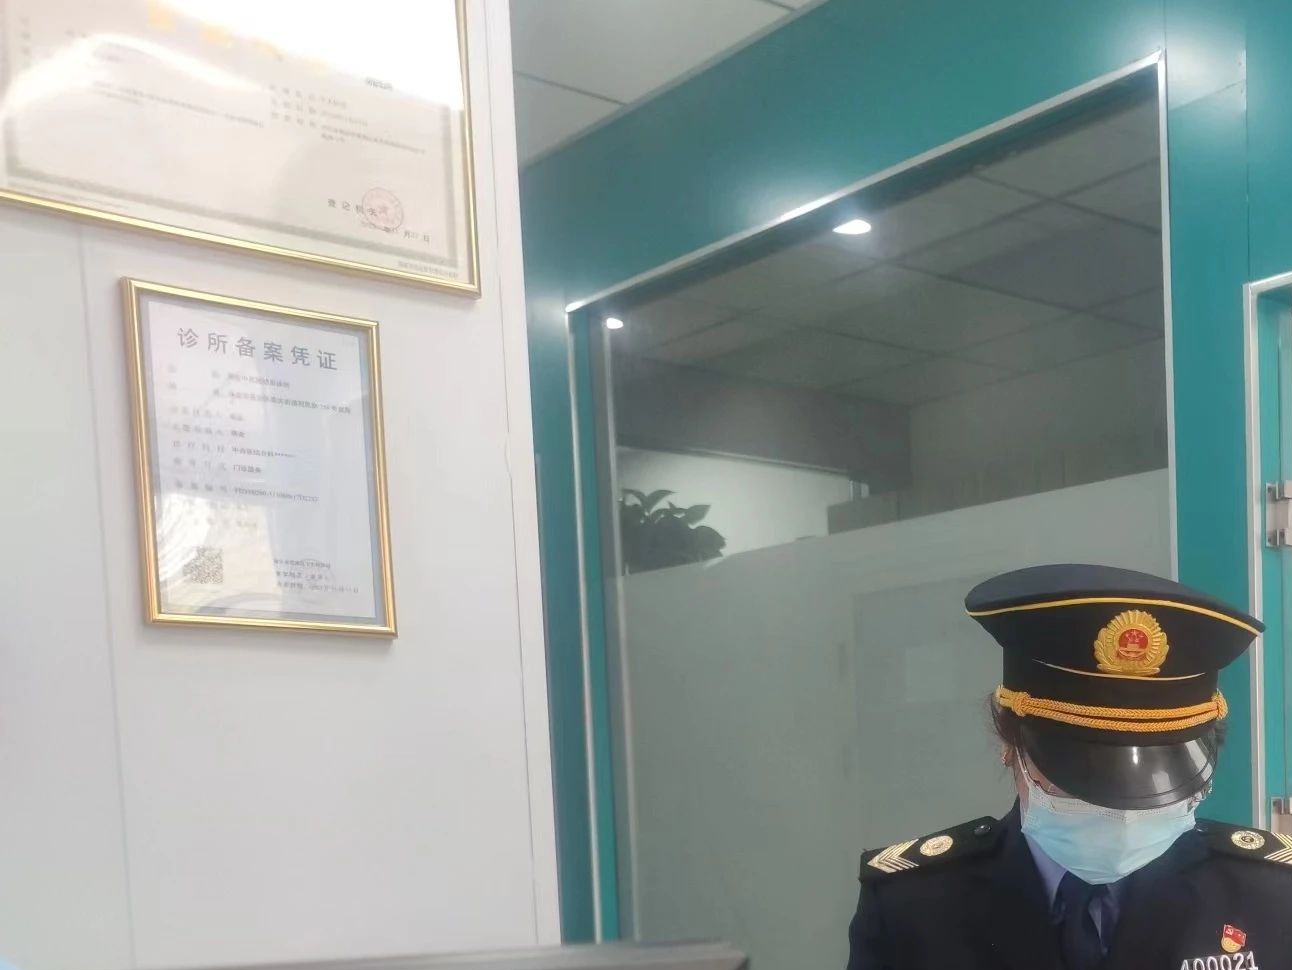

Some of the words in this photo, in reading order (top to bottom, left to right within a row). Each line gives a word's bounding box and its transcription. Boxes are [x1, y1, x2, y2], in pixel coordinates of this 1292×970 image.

[177, 327, 338, 372] 诊所备案凭证
